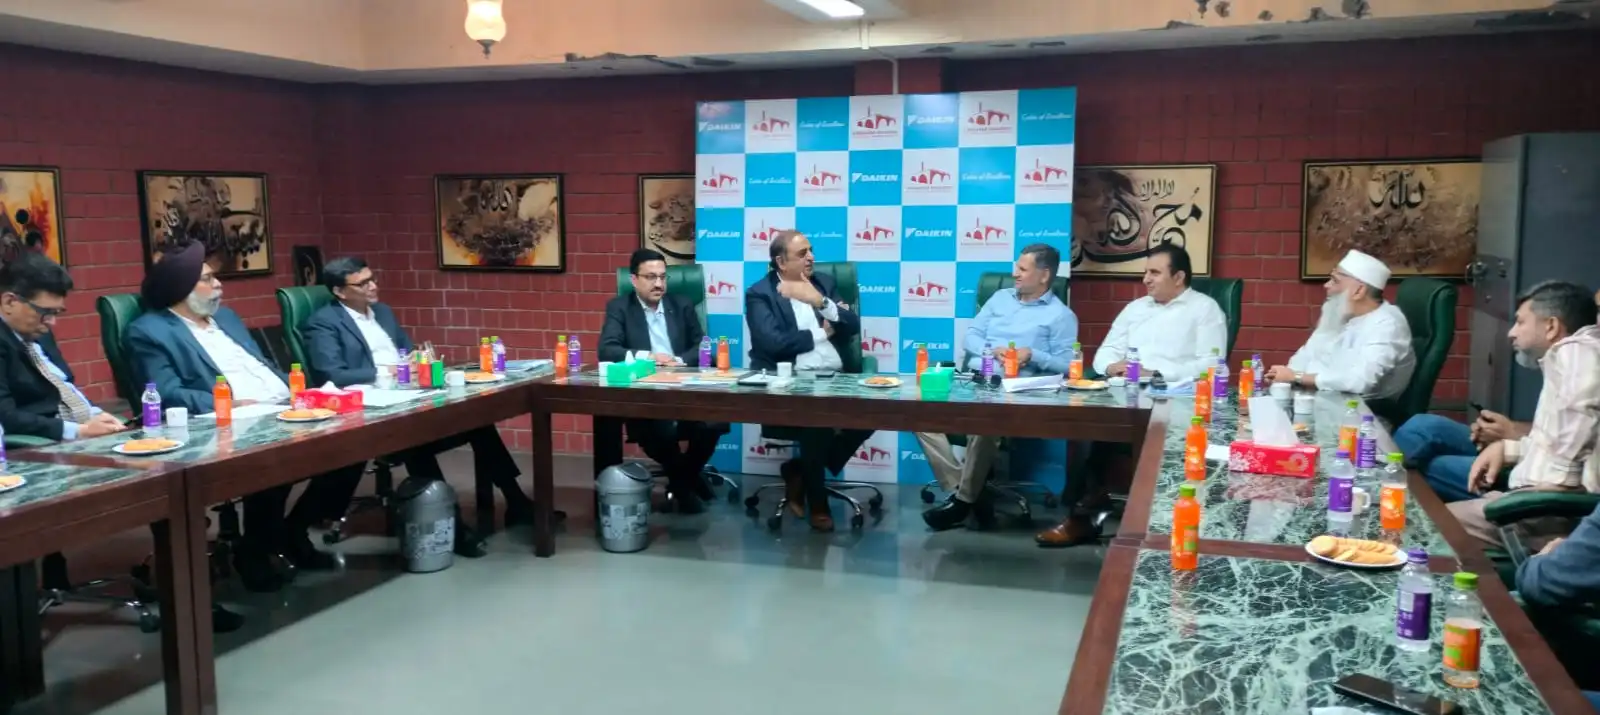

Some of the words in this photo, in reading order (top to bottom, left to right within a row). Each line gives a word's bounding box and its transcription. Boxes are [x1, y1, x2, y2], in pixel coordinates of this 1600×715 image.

[861, 174, 898, 182] DAIKIN
[915, 229, 953, 238] DAIKIN
[859, 285, 896, 293] DAIKIN
